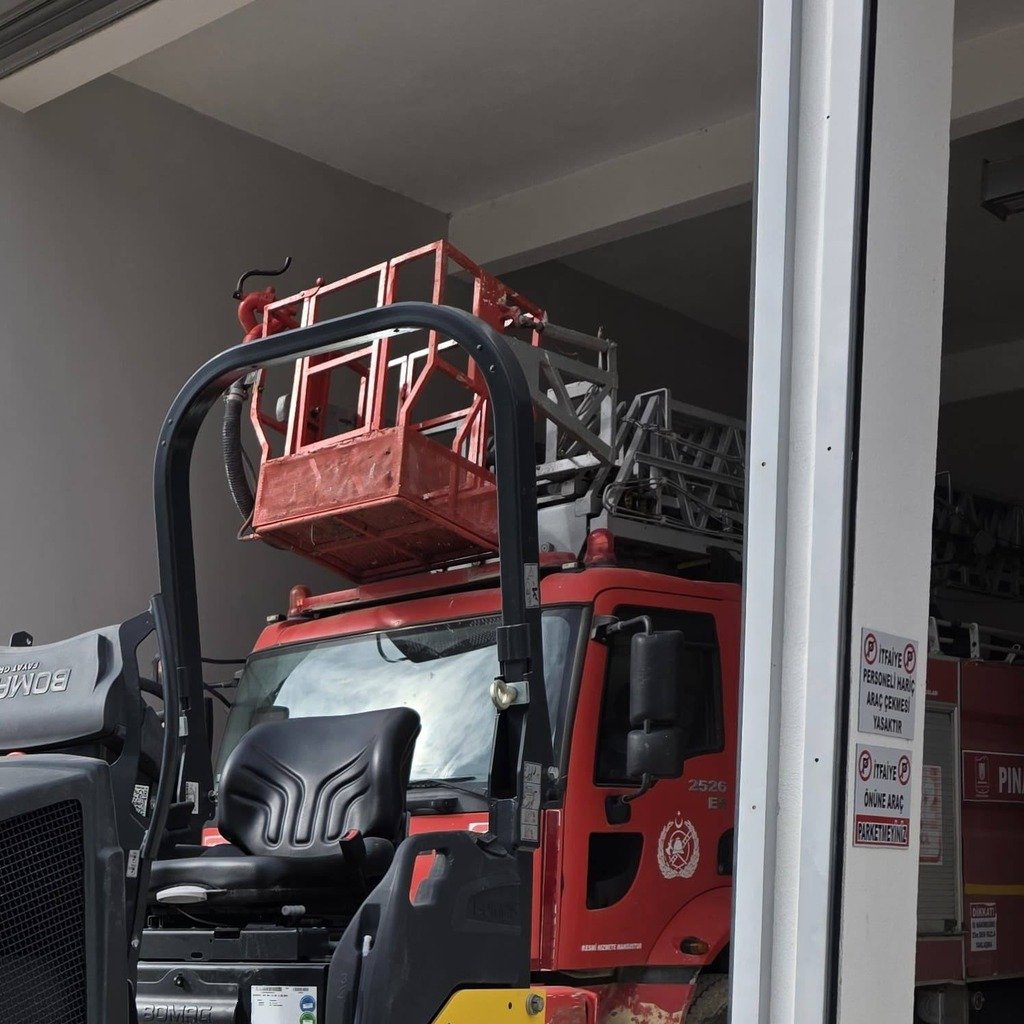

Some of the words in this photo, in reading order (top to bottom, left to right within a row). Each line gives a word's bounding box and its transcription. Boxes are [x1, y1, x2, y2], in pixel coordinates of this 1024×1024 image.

[12, 661, 40, 673] FAYAT
[878, 643, 902, 669] İTFAİYE
[863, 668, 896, 689] PERSONELİ
[896, 676, 915, 697] HARİÇ
[866, 690, 883, 711] ARAÇ
[884, 694, 911, 713] ÇEKMESİ
[873, 714, 903, 734] YASAKTIR
[873, 760, 897, 781] İTFAİYE
[998, 766, 1024, 794] PIN
[688, 779, 728, 793] 2526
[864, 788, 886, 808] ÖNÜNE
[887, 793, 904, 814] ARAÇ
[858, 820, 907, 843] PARKETMEYİNİZ
[143, 1003, 213, 1023] BOMAG
